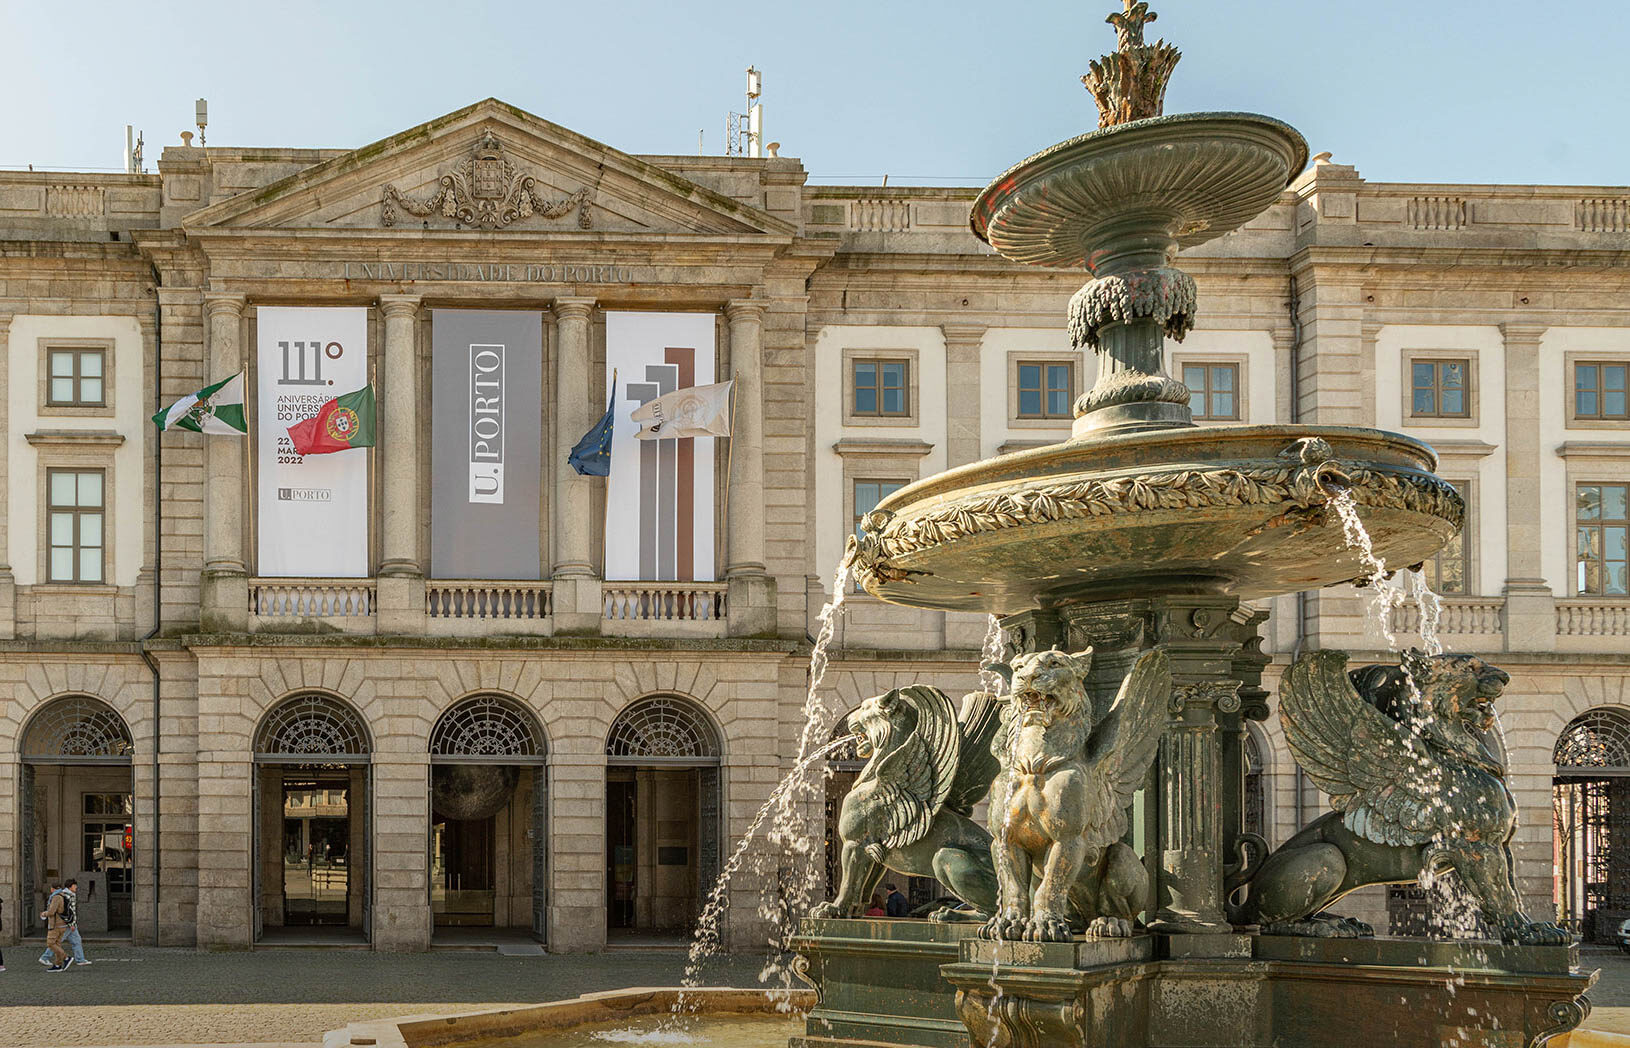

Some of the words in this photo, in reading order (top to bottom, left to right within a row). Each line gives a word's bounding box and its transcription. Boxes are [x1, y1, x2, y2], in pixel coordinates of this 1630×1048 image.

[527, 264, 555, 282] DO
[563, 264, 633, 283] PORTO
[277, 404, 322, 412] UNIVERS
[278, 412, 293, 421] DO
[296, 412, 317, 421] POR
[278, 437, 290, 445] 22
[278, 456, 303, 464] 2022
